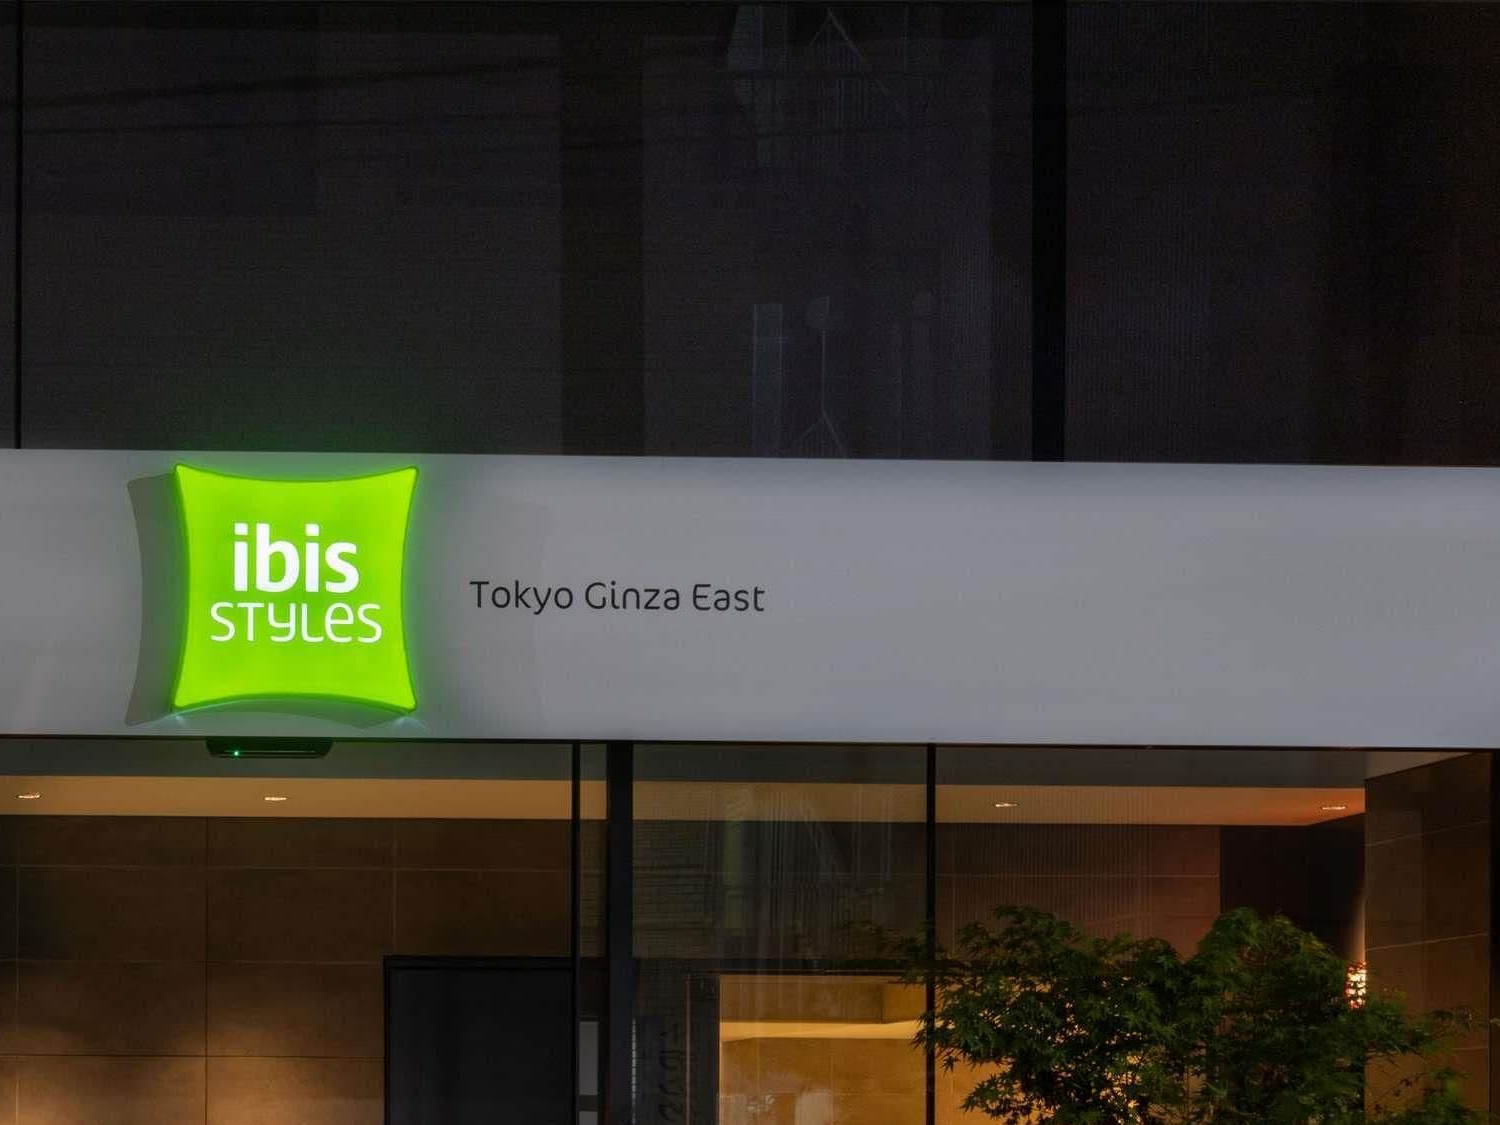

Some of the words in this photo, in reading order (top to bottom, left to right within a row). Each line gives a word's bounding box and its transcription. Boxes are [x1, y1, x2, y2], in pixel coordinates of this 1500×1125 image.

[233, 522, 360, 594] ibis
[469, 580, 574, 616] Tokyo
[584, 581, 681, 611] Ginza
[692, 583, 766, 613] East
